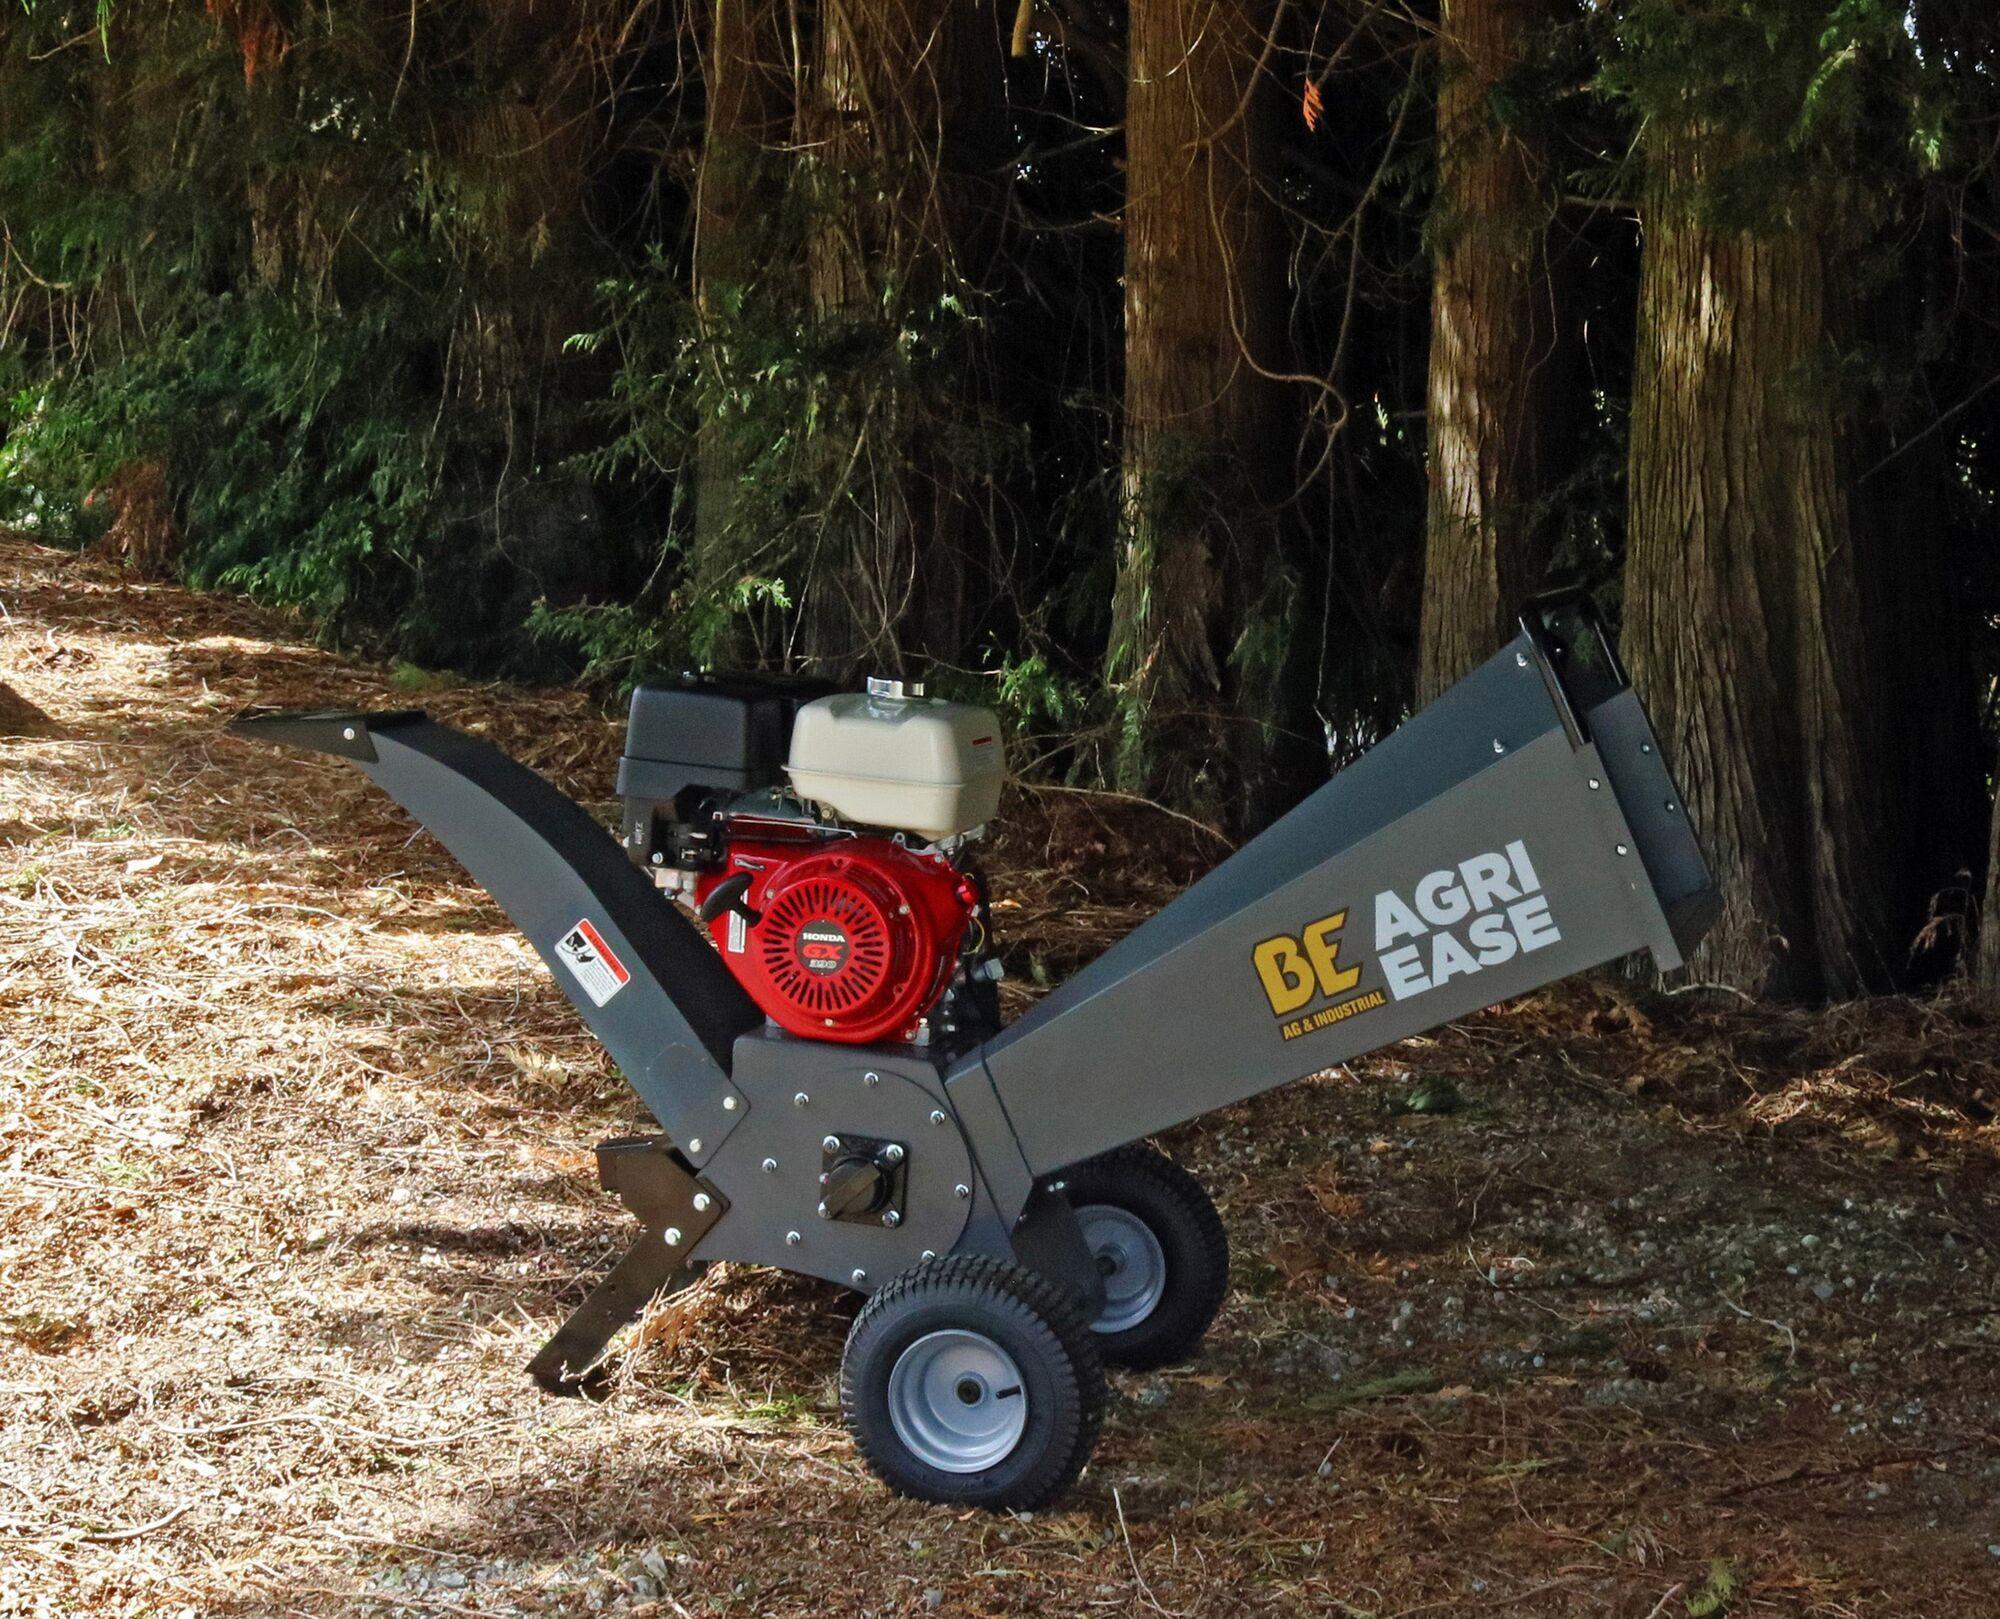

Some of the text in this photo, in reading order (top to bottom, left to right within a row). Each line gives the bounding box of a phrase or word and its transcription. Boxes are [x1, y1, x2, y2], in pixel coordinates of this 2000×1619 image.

[1375, 839, 1541, 951] AGRI
[803, 932, 845, 943] HONDA
[803, 943, 843, 959] GX
[1253, 908, 1361, 1016] BE
[1378, 895, 1561, 1001] EASE
[1283, 991, 1386, 1039] AG & INDUSTRIAL
